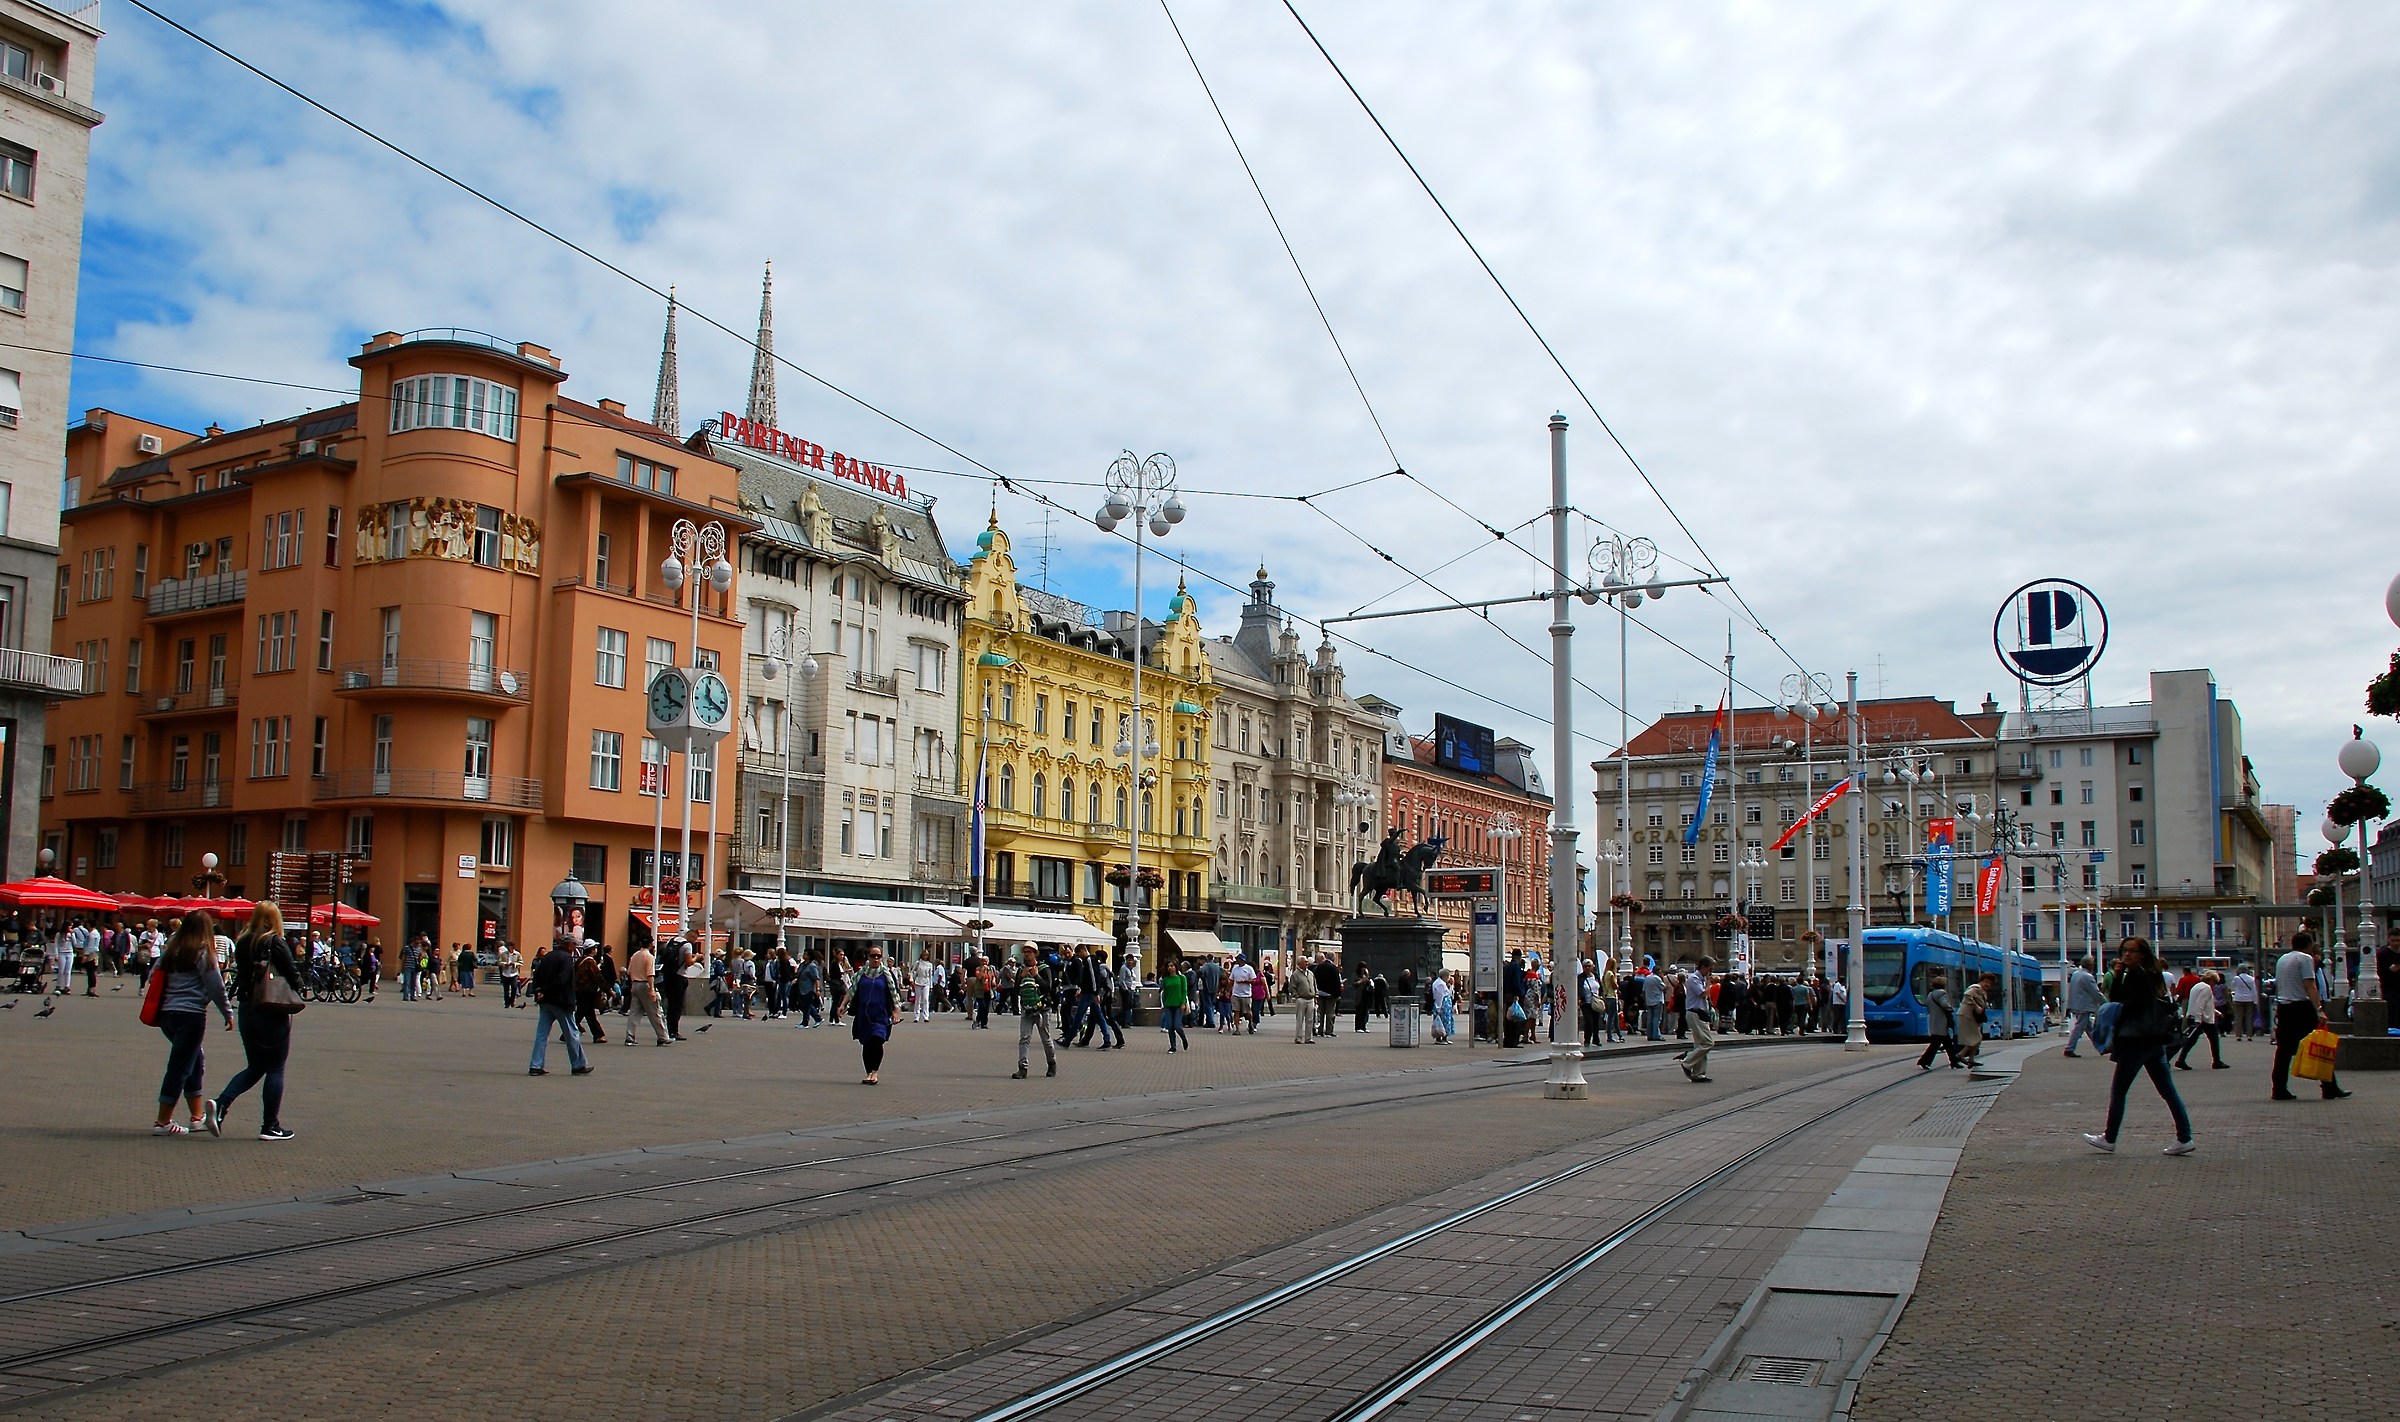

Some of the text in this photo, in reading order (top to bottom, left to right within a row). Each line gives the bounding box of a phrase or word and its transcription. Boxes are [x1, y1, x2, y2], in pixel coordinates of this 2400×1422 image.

[722, 411, 907, 500] PARTNER BANKA
[1938, 894, 1947, 912] 2015
